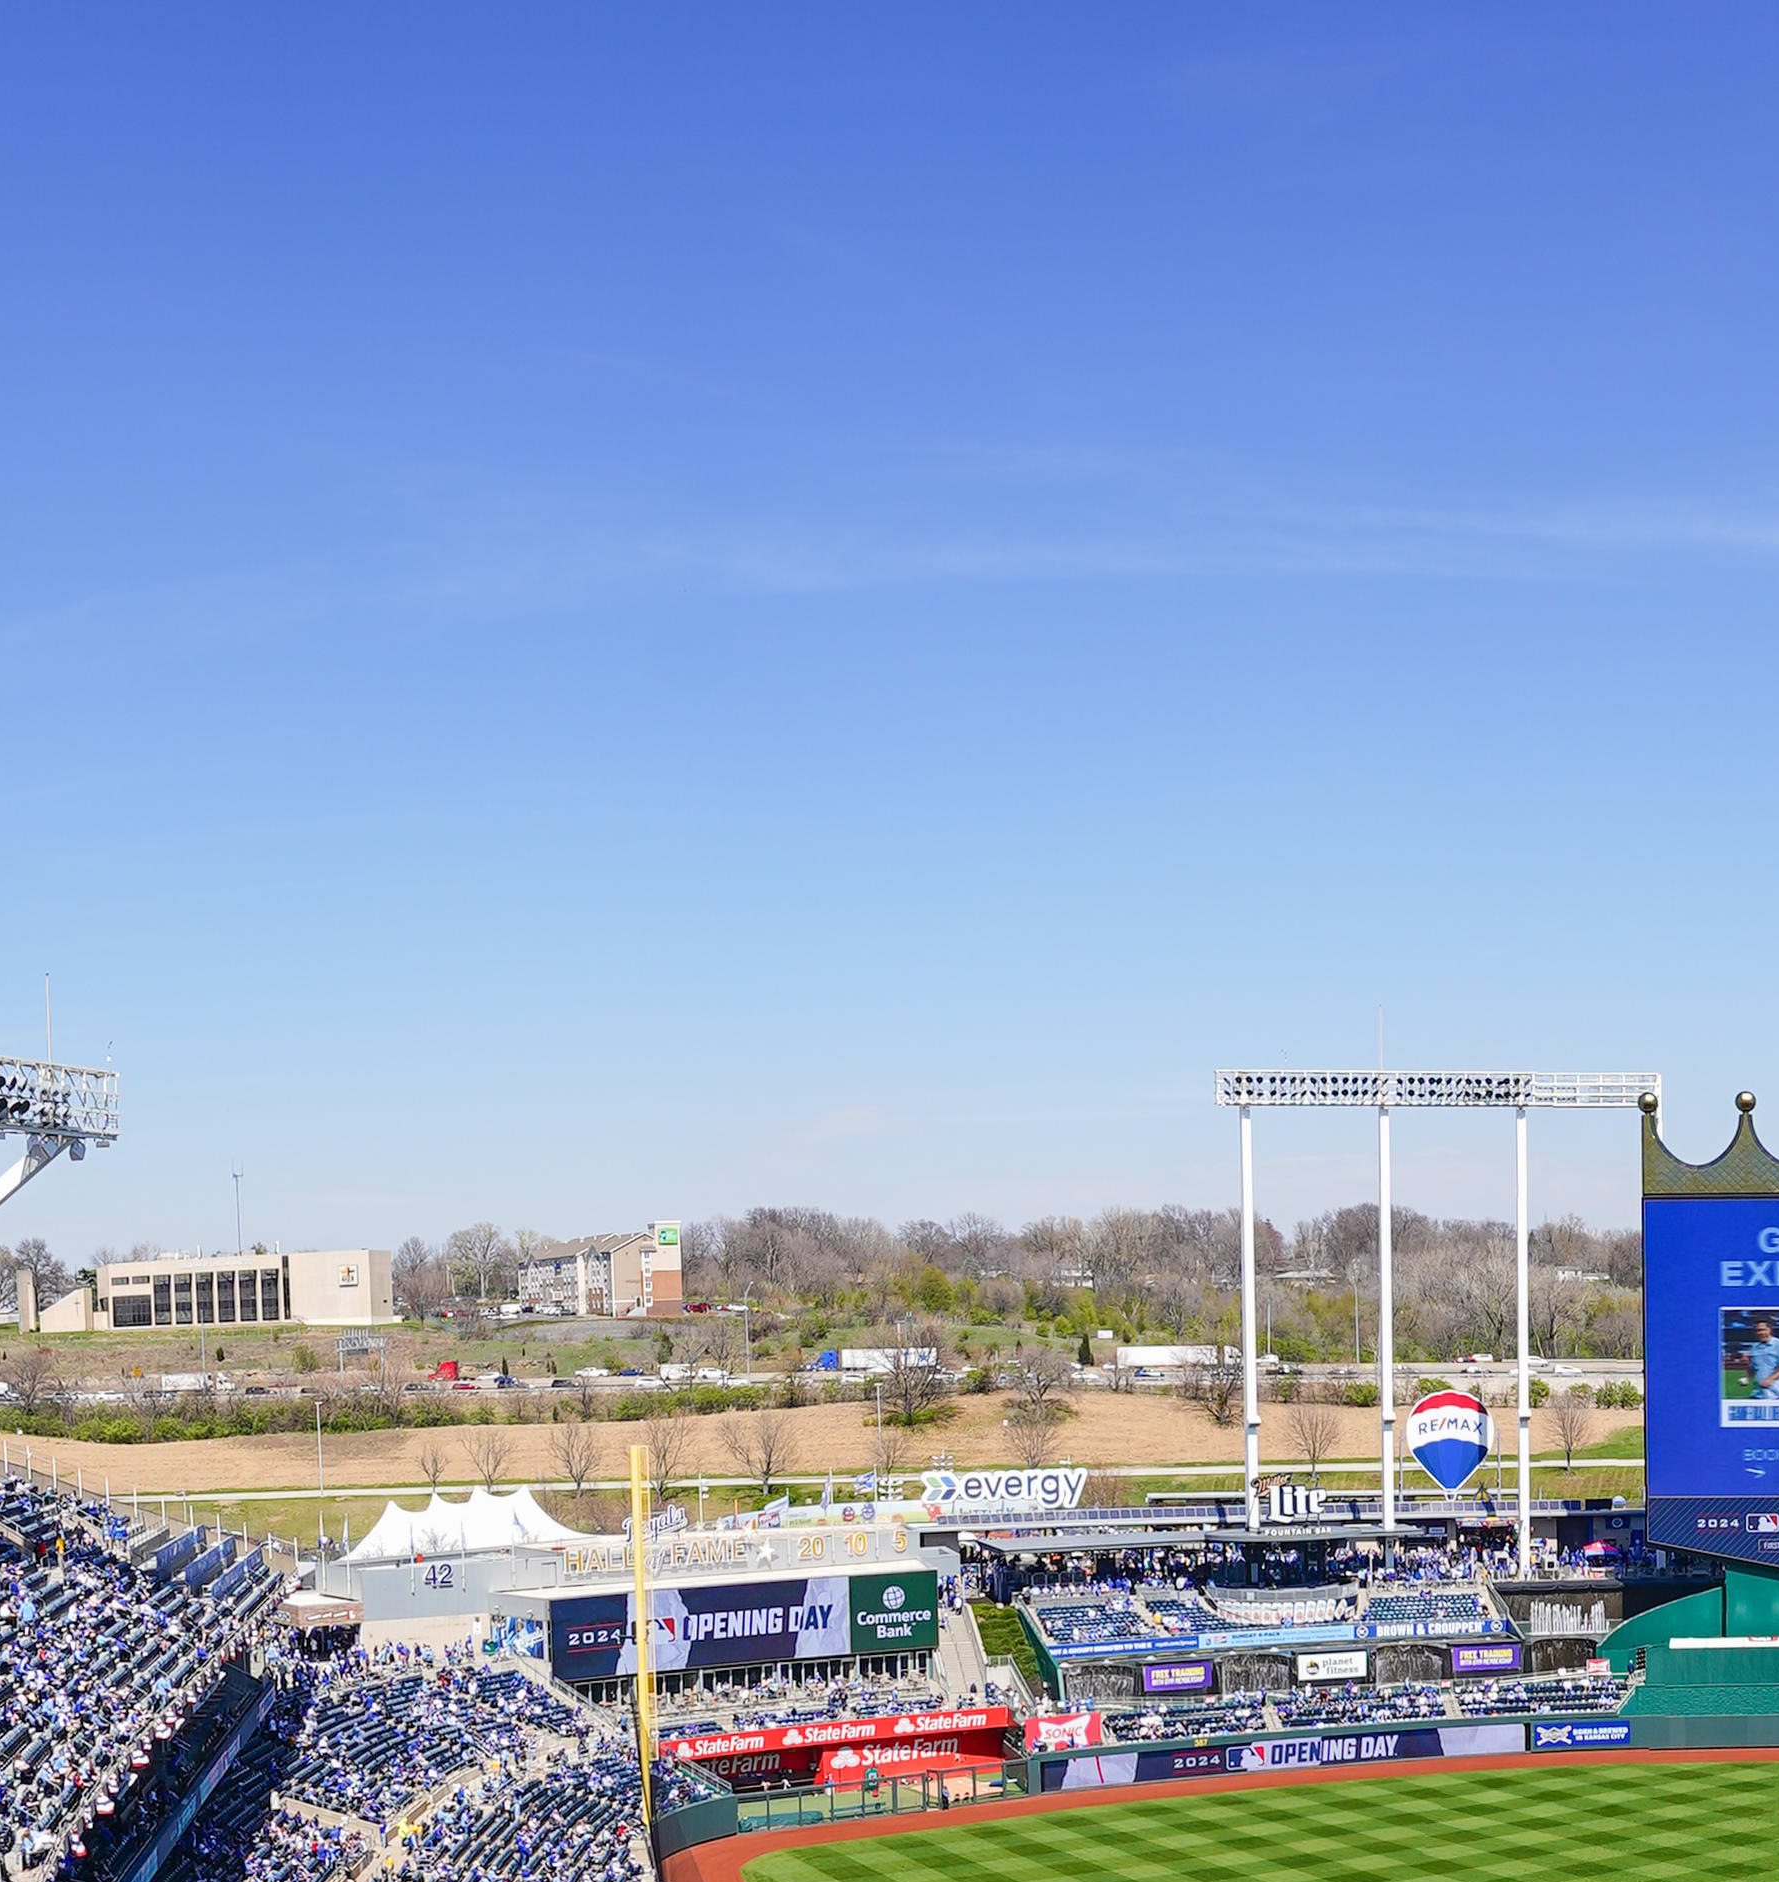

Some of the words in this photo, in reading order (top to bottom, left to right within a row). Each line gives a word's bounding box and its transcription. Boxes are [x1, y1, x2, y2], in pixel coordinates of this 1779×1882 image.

[1418, 1418, 1484, 1436] RE/MAX
[964, 1469, 1084, 1506] evergy
[1251, 1473, 1293, 1497] Miller
[1268, 1484, 1327, 1525] Lite
[1264, 1527, 1312, 1536] FOUNTAIN
[1316, 1525, 1332, 1535] BAR
[1697, 1518, 1740, 1529] 2024
[798, 1536, 826, 1560] 20
[844, 1532, 867, 1556] 10
[893, 1529, 907, 1552] 5
[565, 1546, 635, 1575] HALL
[671, 1537, 748, 1566] FAME
[424, 1563, 453, 1585] 42
[567, 1627, 622, 1646] 2024
[683, 1607, 788, 1641] OPENING
[789, 1604, 834, 1634] DAY
[856, 1609, 932, 1626] Commerce
[876, 1622, 913, 1639] Bank
[1377, 1624, 1415, 1637] BROWN
[1417, 1624, 1425, 1635] &
[1427, 1621, 1483, 1636] CROUPPEN
[1322, 1657, 1353, 1669] planet
[1459, 1649, 1478, 1660] FREE
[1478, 1648, 1513, 1659] TRAINING
[1151, 1668, 1170, 1679] FREE
[1170, 1666, 1205, 1678] TRAINING
[1326, 1665, 1359, 1675] fitness
[915, 1711, 988, 1731] StateFarm
[1572, 1727, 1593, 1735] BORN
[1598, 1726, 1629, 1734] BREWED
[805, 1721, 876, 1743] StateFarm
[1043, 1724, 1083, 1741] SONIC
[1584, 1733, 1610, 1741] KANSAS
[693, 1735, 765, 1758] StateFarm
[861, 1736, 959, 1765] StateFarm
[1173, 1754, 1222, 1770] 2024
[1271, 1737, 1358, 1765] OPENING
[1360, 1734, 1399, 1759] DAY
